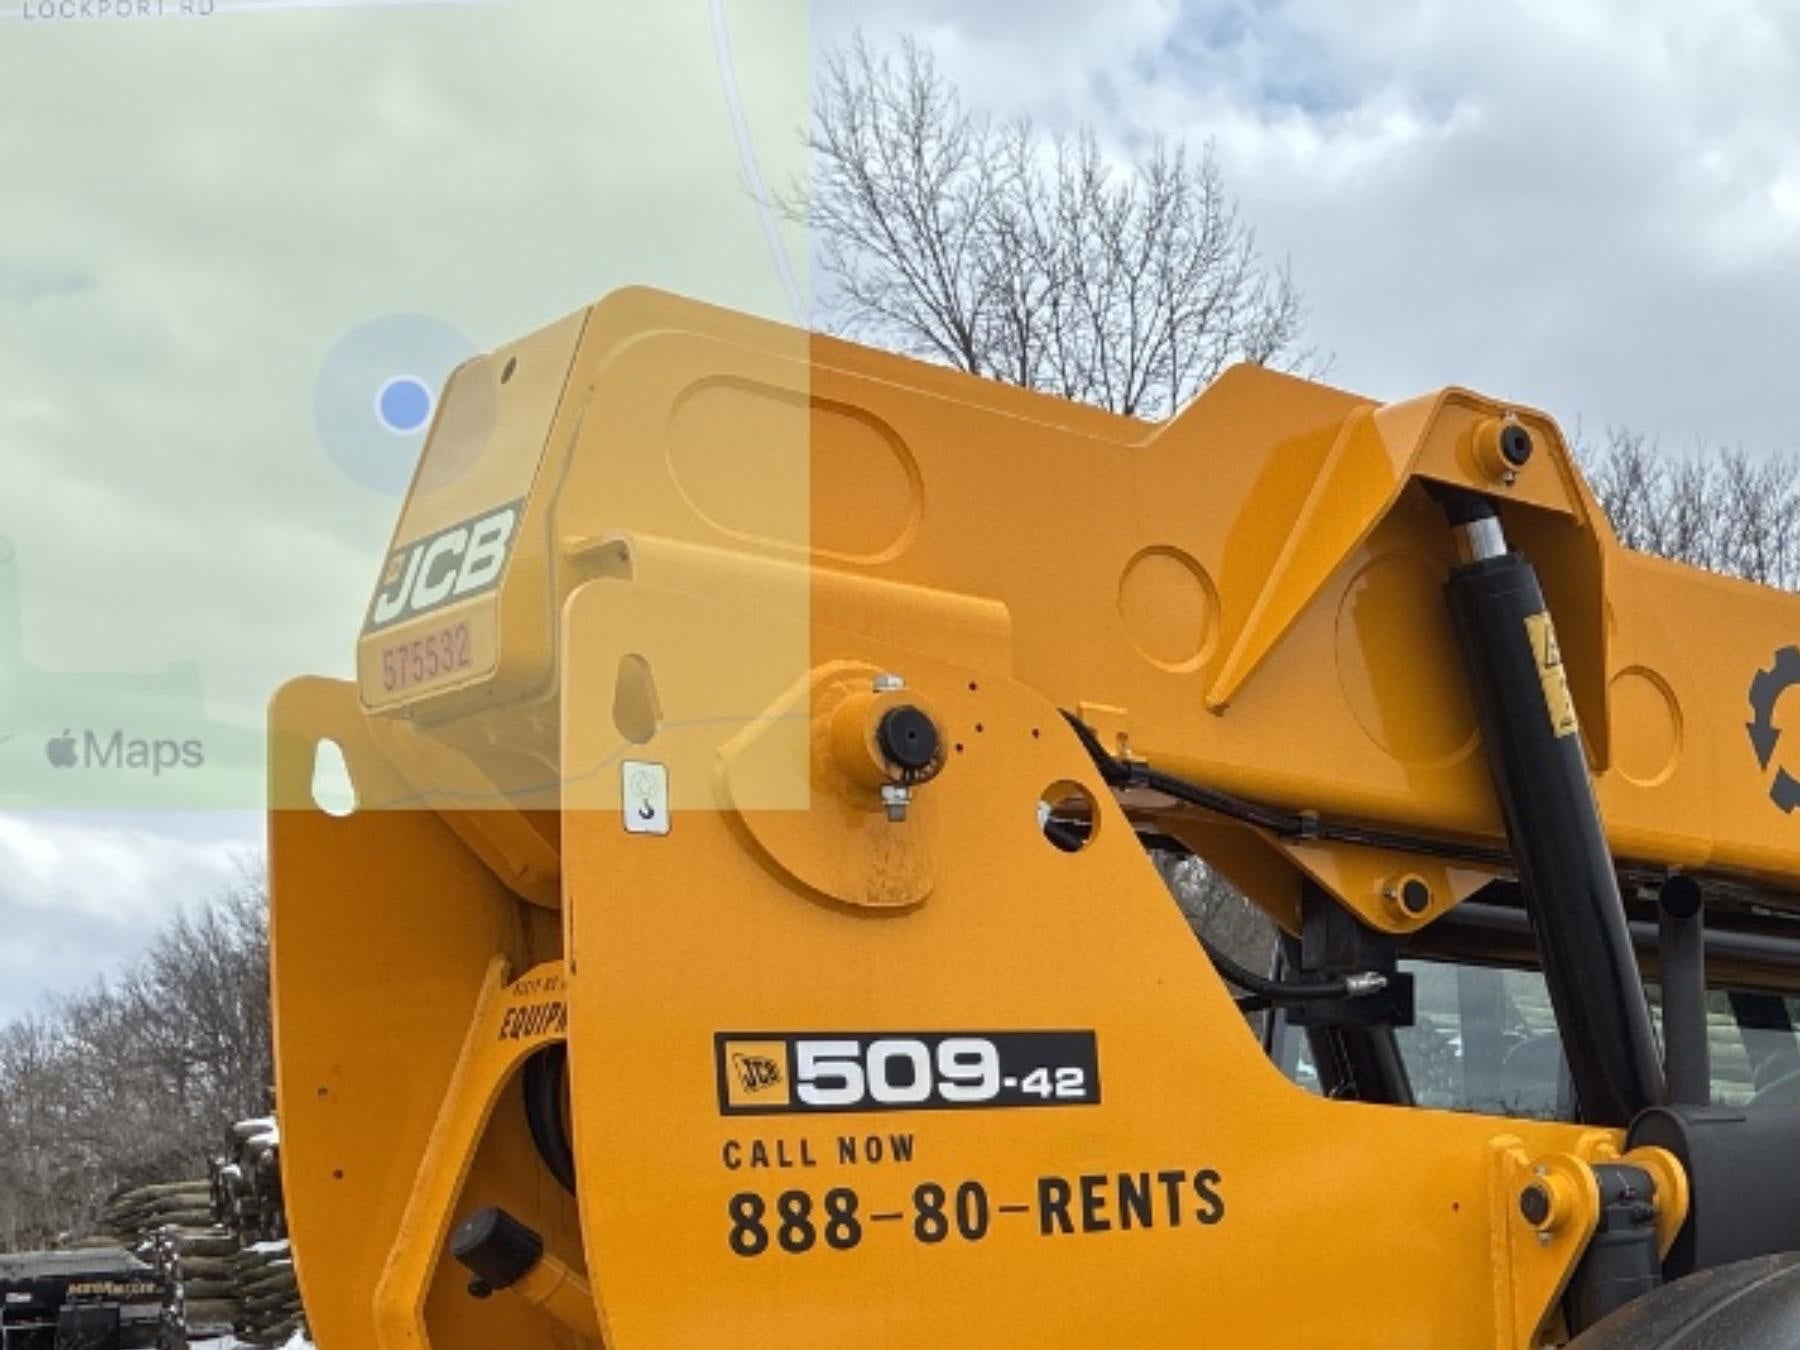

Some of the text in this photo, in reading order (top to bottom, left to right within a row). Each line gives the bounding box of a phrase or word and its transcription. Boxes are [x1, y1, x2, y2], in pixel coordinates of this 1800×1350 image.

[374, 509, 515, 624] JCB
[382, 621, 471, 691] 575532
[795, 1038, 1086, 1105] 509-42
[722, 1134, 916, 1170] CALL NOW
[728, 1169, 1226, 1257] 888-80-RENTS
